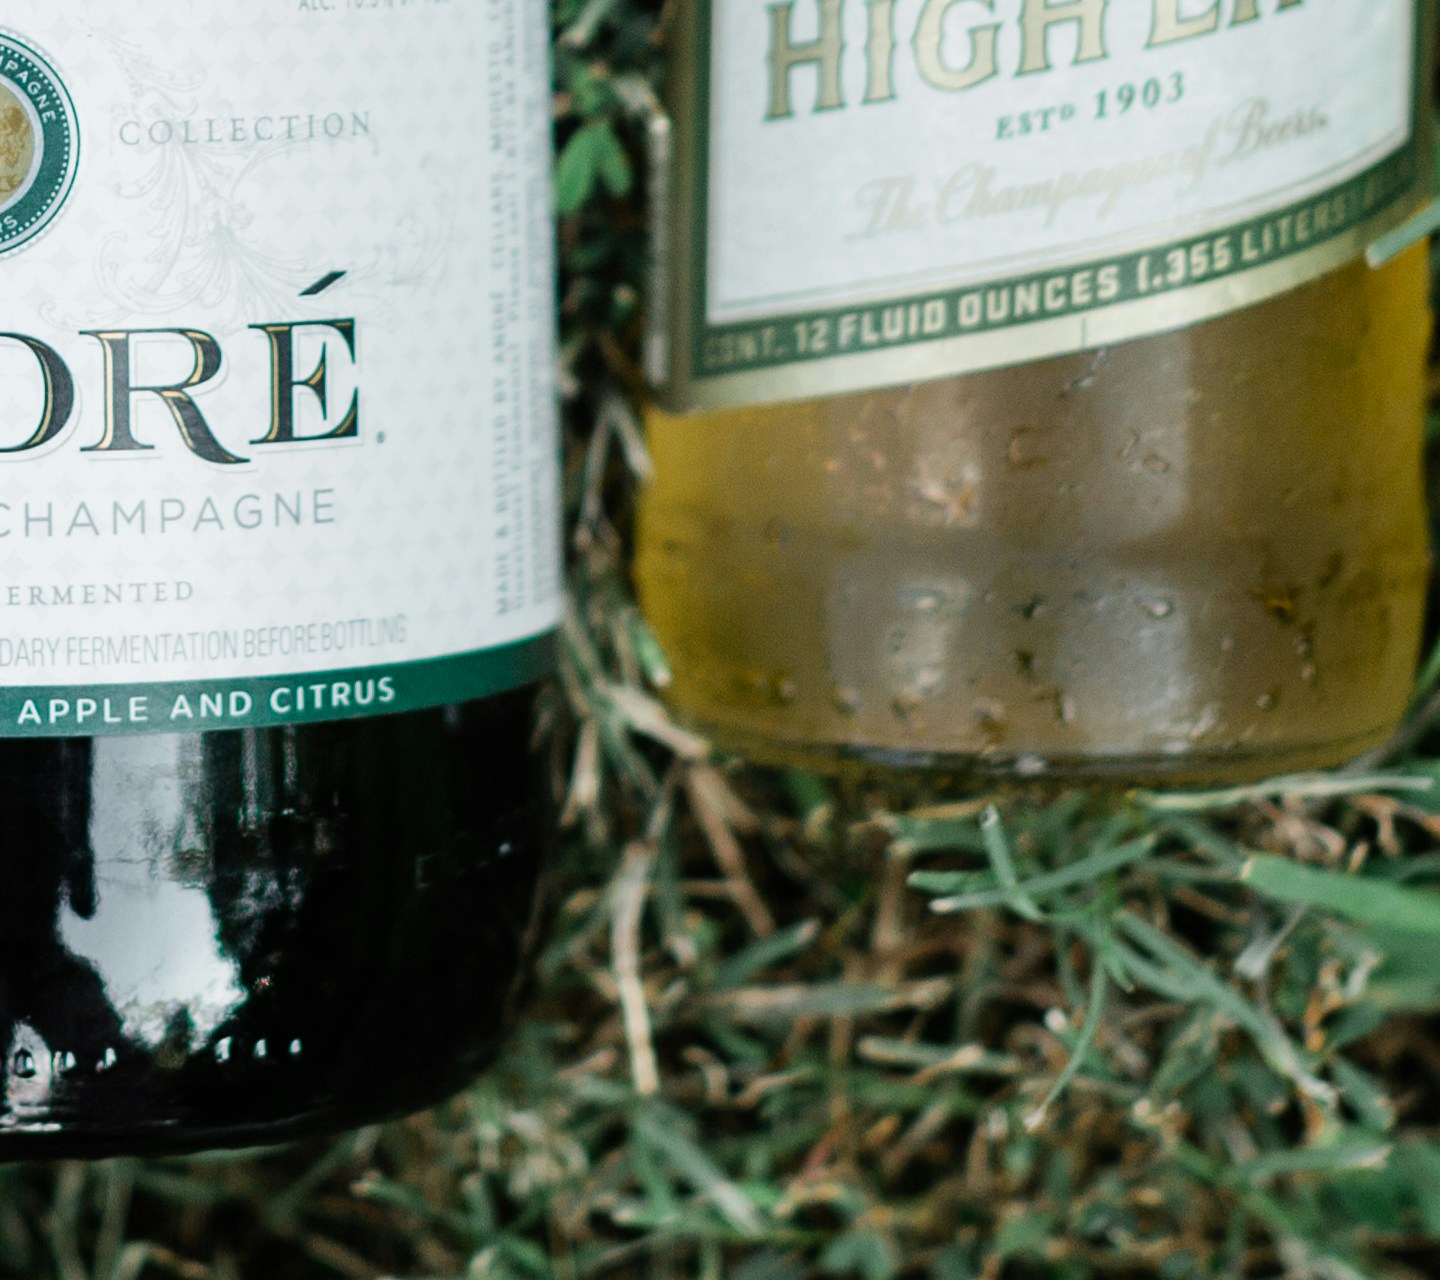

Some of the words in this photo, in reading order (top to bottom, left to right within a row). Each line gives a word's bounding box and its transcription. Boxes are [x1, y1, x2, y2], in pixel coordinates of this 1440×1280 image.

[1093, 72, 1185, 120] 1903
[118, 110, 371, 147] COLLECTION
[794, 320, 828, 354] 12
[839, 297, 947, 348] FLUID
[958, 264, 1121, 328] OUNCES
[66, 629, 238, 666] FERMENTATION
[244, 623, 318, 659] BEFORE
[320, 613, 408, 653] BOTTLING
[17, 695, 149, 725] APPLE
[169, 689, 253, 720] AND
[269, 676, 397, 714] CITRUS
